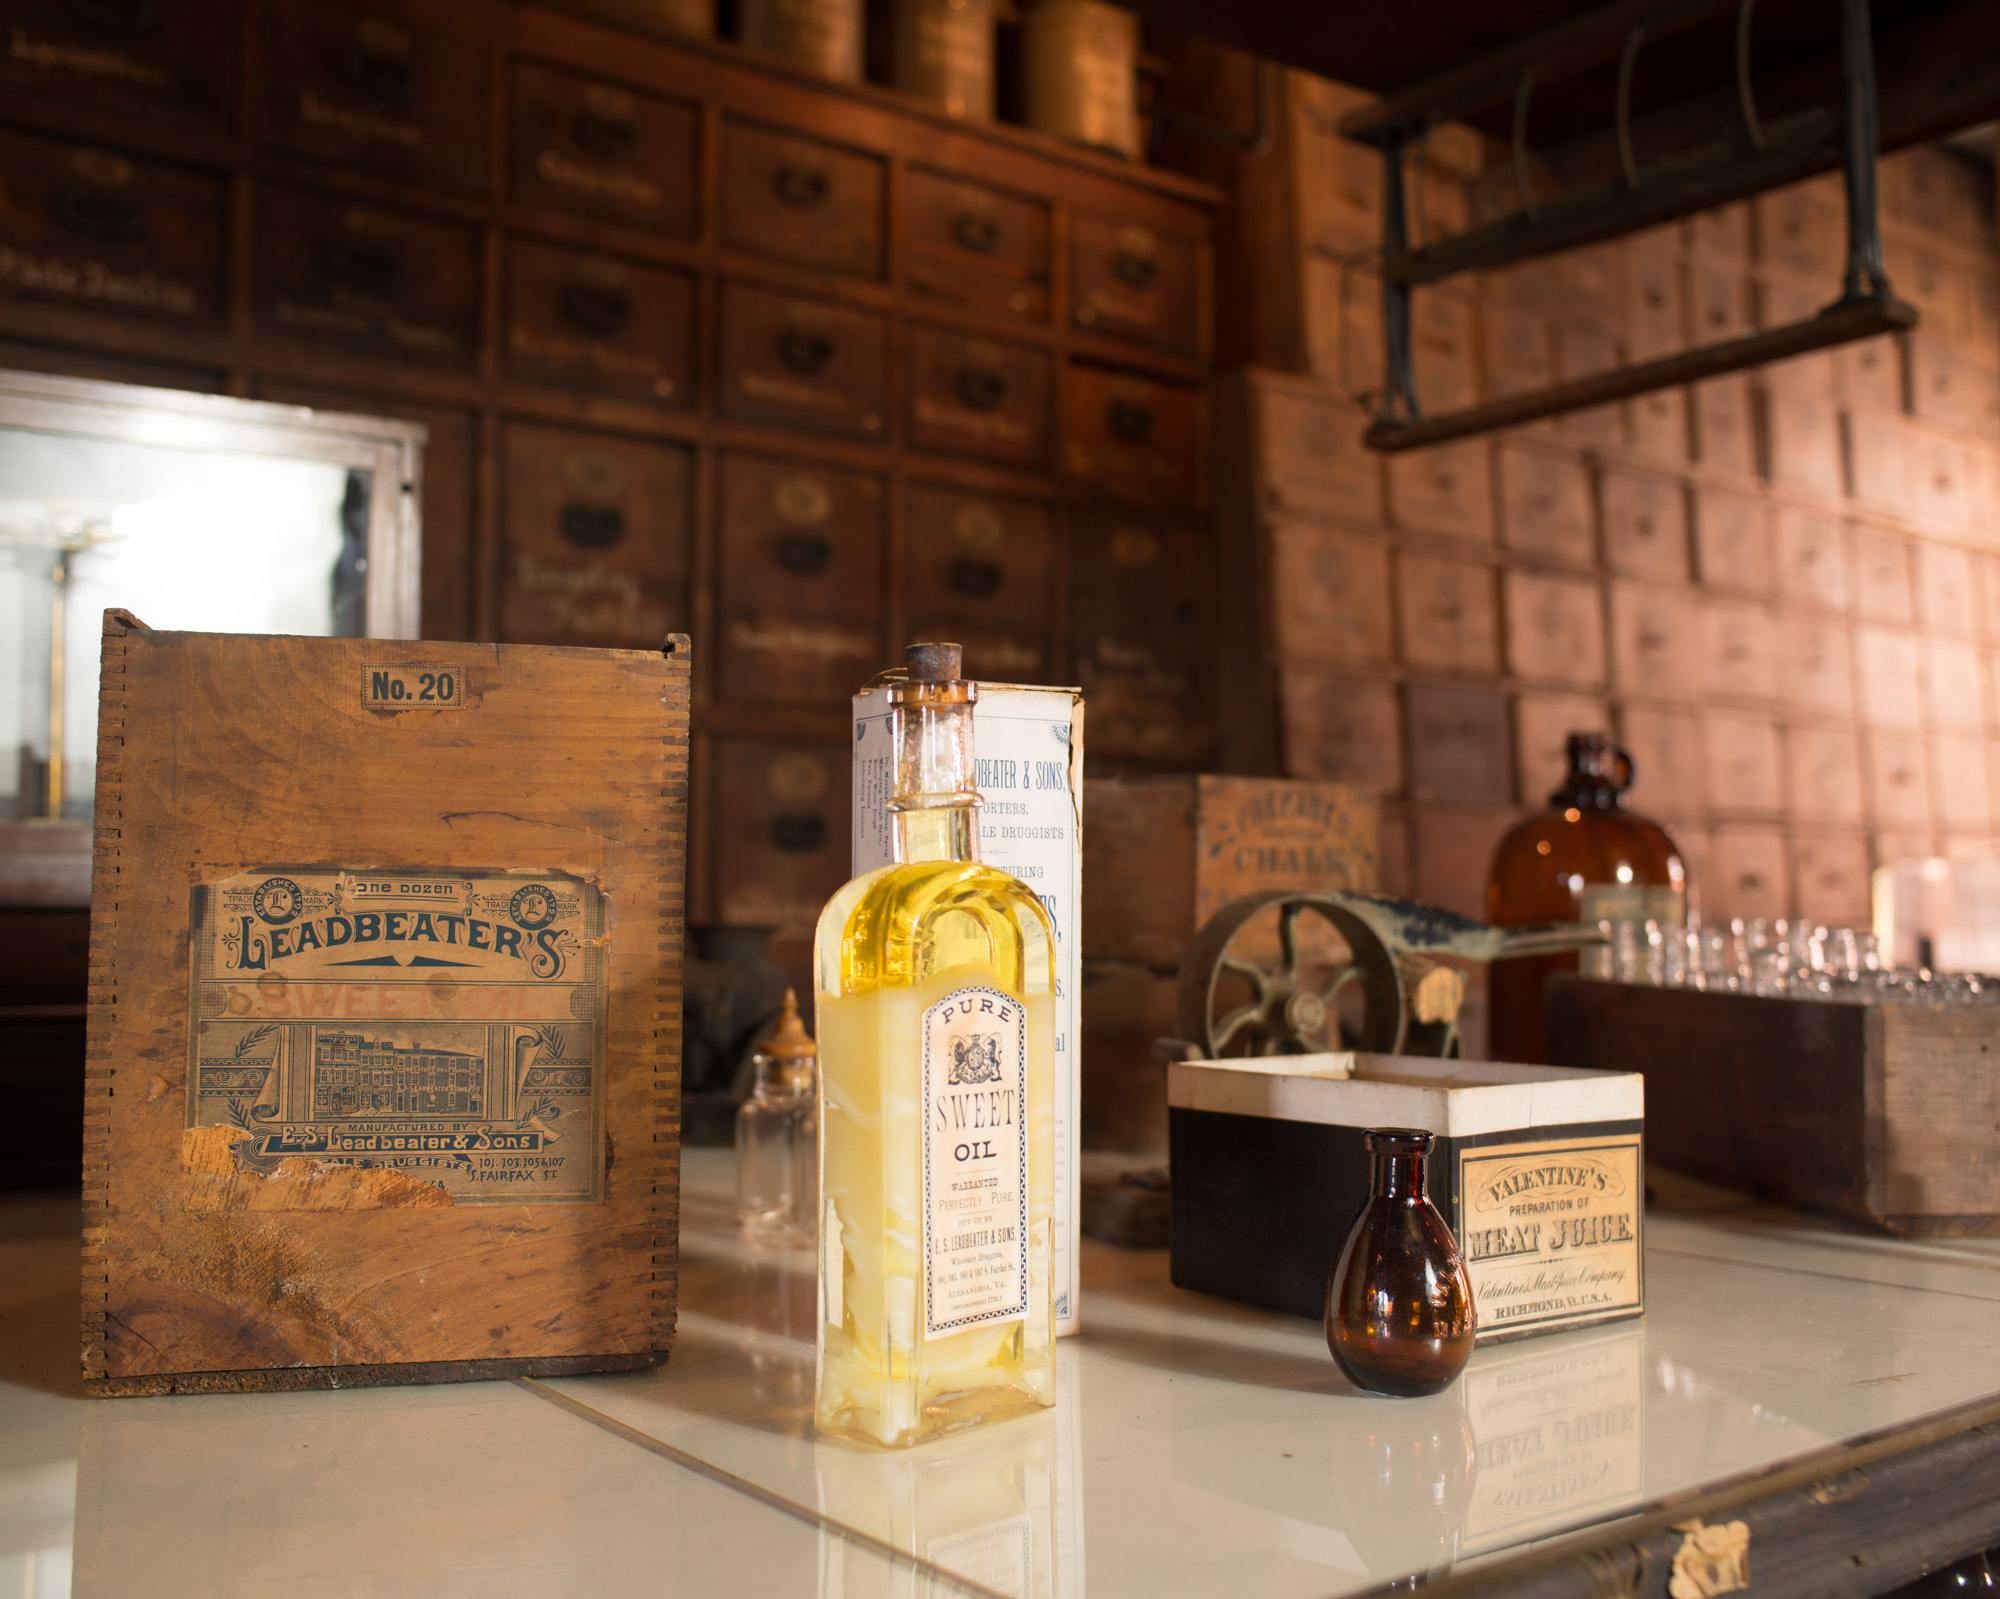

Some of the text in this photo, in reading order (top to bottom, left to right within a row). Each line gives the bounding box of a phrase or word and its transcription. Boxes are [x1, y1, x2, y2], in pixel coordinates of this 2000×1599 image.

[373, 672, 454, 700] No. 20
[1023, 761, 1030, 789] &
[1036, 761, 1066, 791] SONS,
[1001, 826, 1064, 839] DRUGGISTS
[228, 896, 325, 905] TRADE MARK
[255, 879, 296, 917] ESTABLISHED
[486, 901, 578, 910] TRADE MARK
[512, 885, 550, 922] ESTABLISHED
[238, 912, 568, 979] LEADBEATER'S
[258, 984, 541, 1019] SWEET OIL
[942, 998, 1012, 1024] PURE
[936, 1088, 1015, 1133] SWEET
[325, 1125, 450, 1151] Leadbeater
[453, 1134, 470, 1150] &
[472, 1125, 531, 1151] Sons
[347, 1123, 469, 1132] MANUFACTURED BY
[954, 1140, 998, 1162] OIL
[951, 1177, 999, 1192] WARRANTED
[1488, 1167, 1609, 1203] VALENTINE'S
[1509, 1197, 1590, 1216] PREPARATION OF
[958, 1215, 993, 1227] PUT UP BY
[951, 1230, 989, 1251] LEADBEATER
[991, 1229, 996, 1244] &
[1468, 1223, 1541, 1262] MEAT
